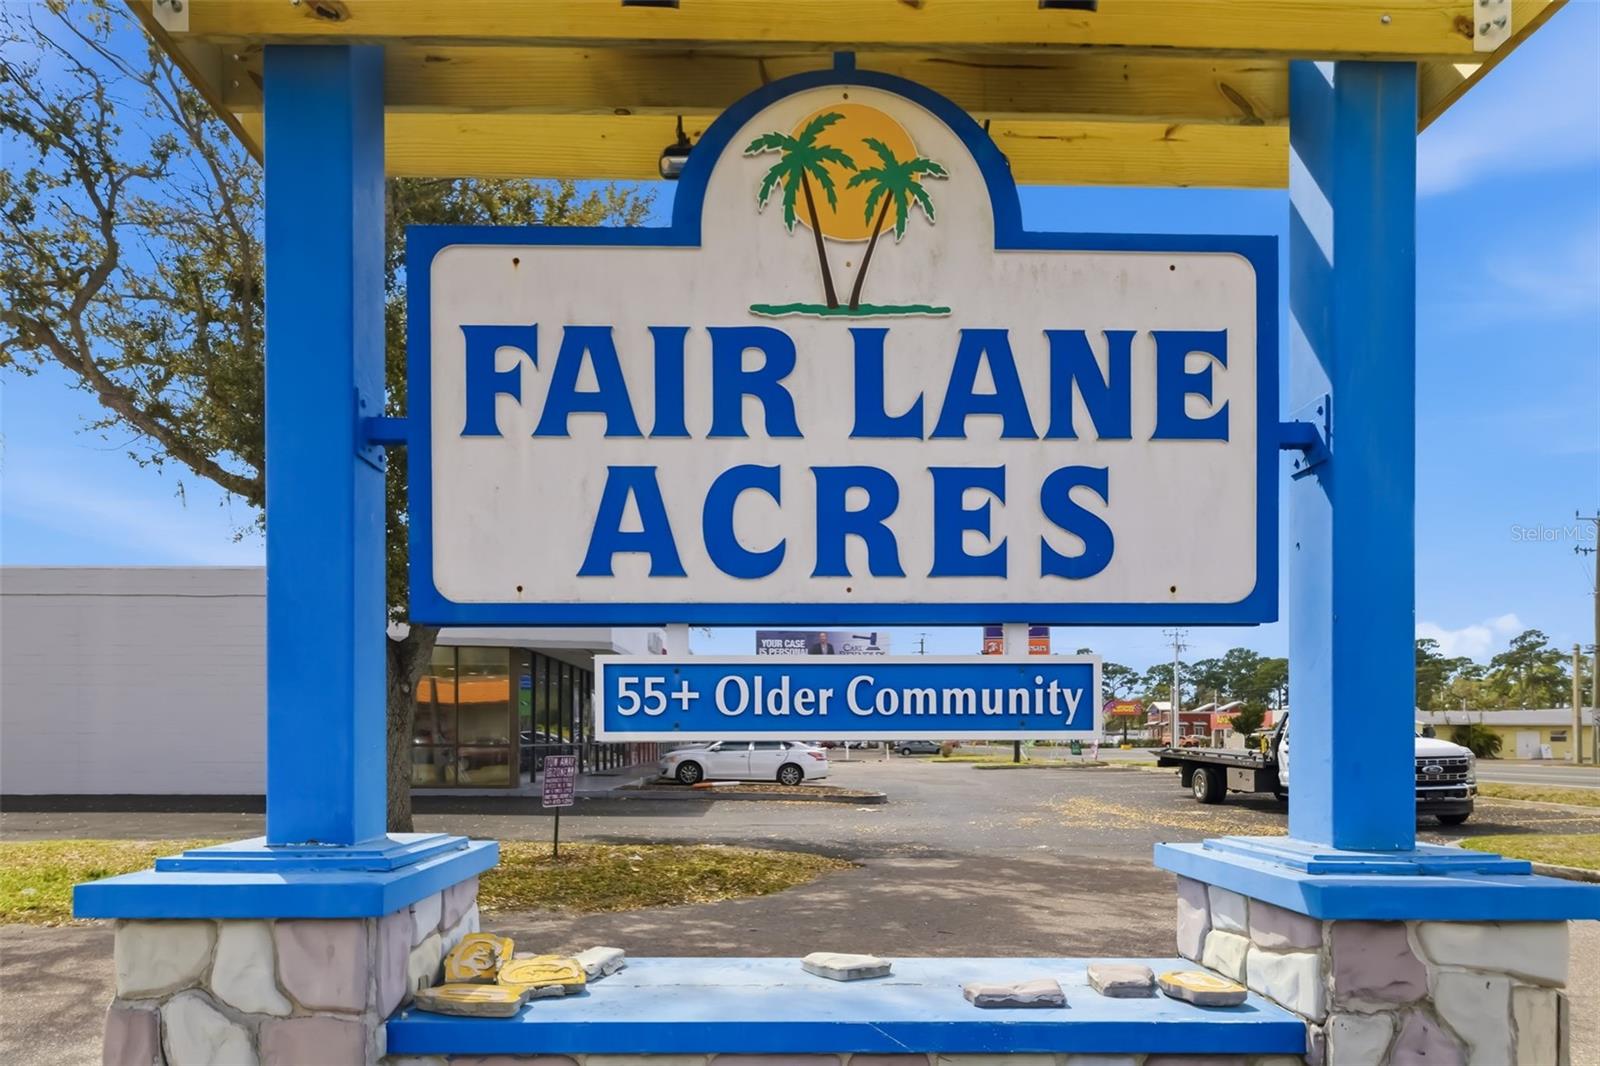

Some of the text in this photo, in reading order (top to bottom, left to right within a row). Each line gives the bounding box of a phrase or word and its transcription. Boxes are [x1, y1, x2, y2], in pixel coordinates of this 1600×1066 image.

[461, 324, 1229, 441] FAIR LANE
[578, 464, 1114, 579] ACRES
[761, 639, 806, 648] YOUR CASE
[617, 675, 1083, 726] 55+ Older Community
